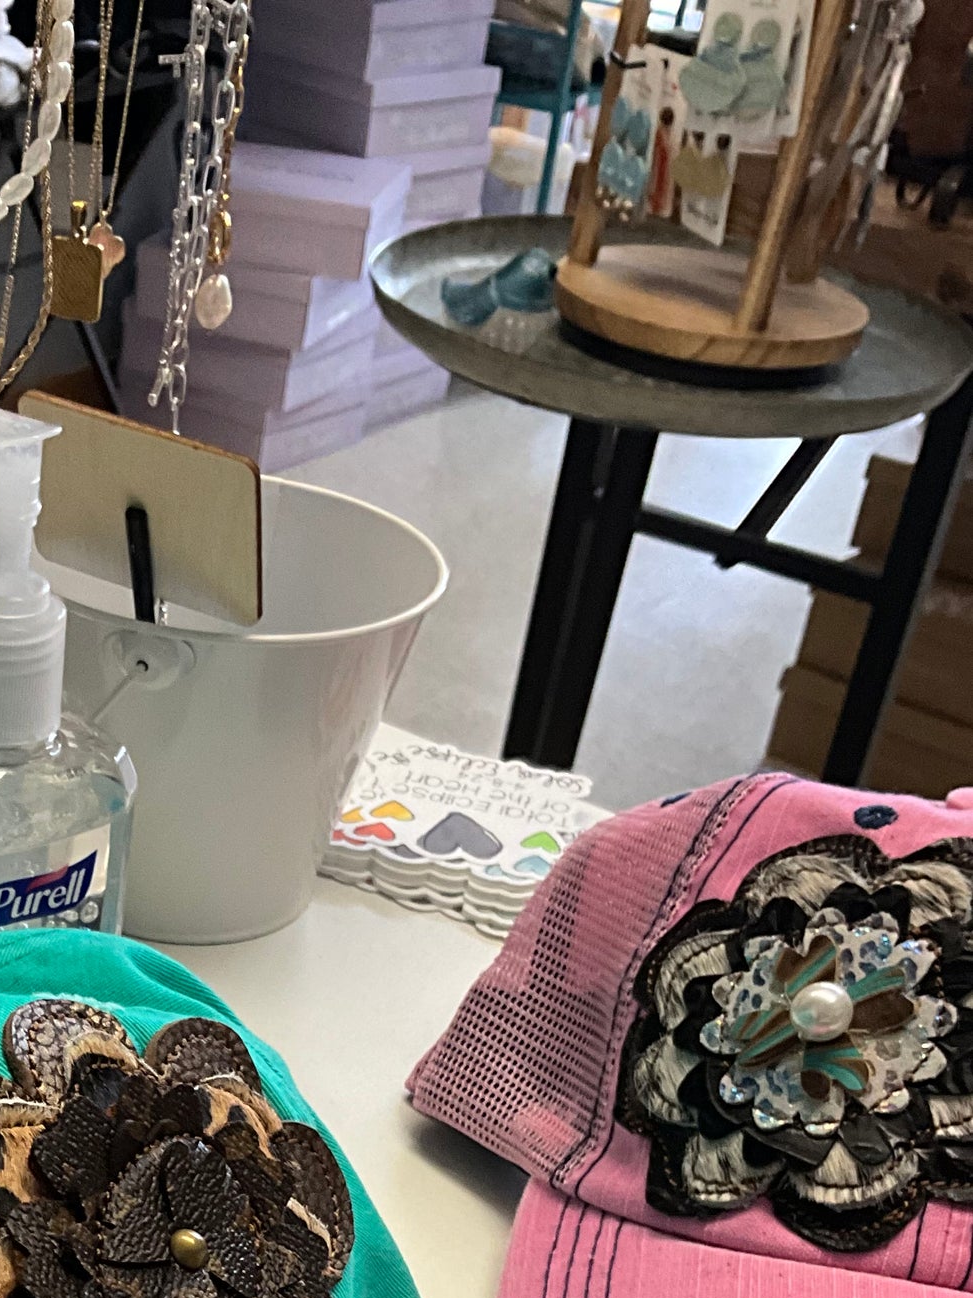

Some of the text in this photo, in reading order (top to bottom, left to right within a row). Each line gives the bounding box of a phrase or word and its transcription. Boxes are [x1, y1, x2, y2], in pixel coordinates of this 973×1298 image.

[405, 770, 483, 795] Heart
[391, 783, 570, 828] Total Eclipse
